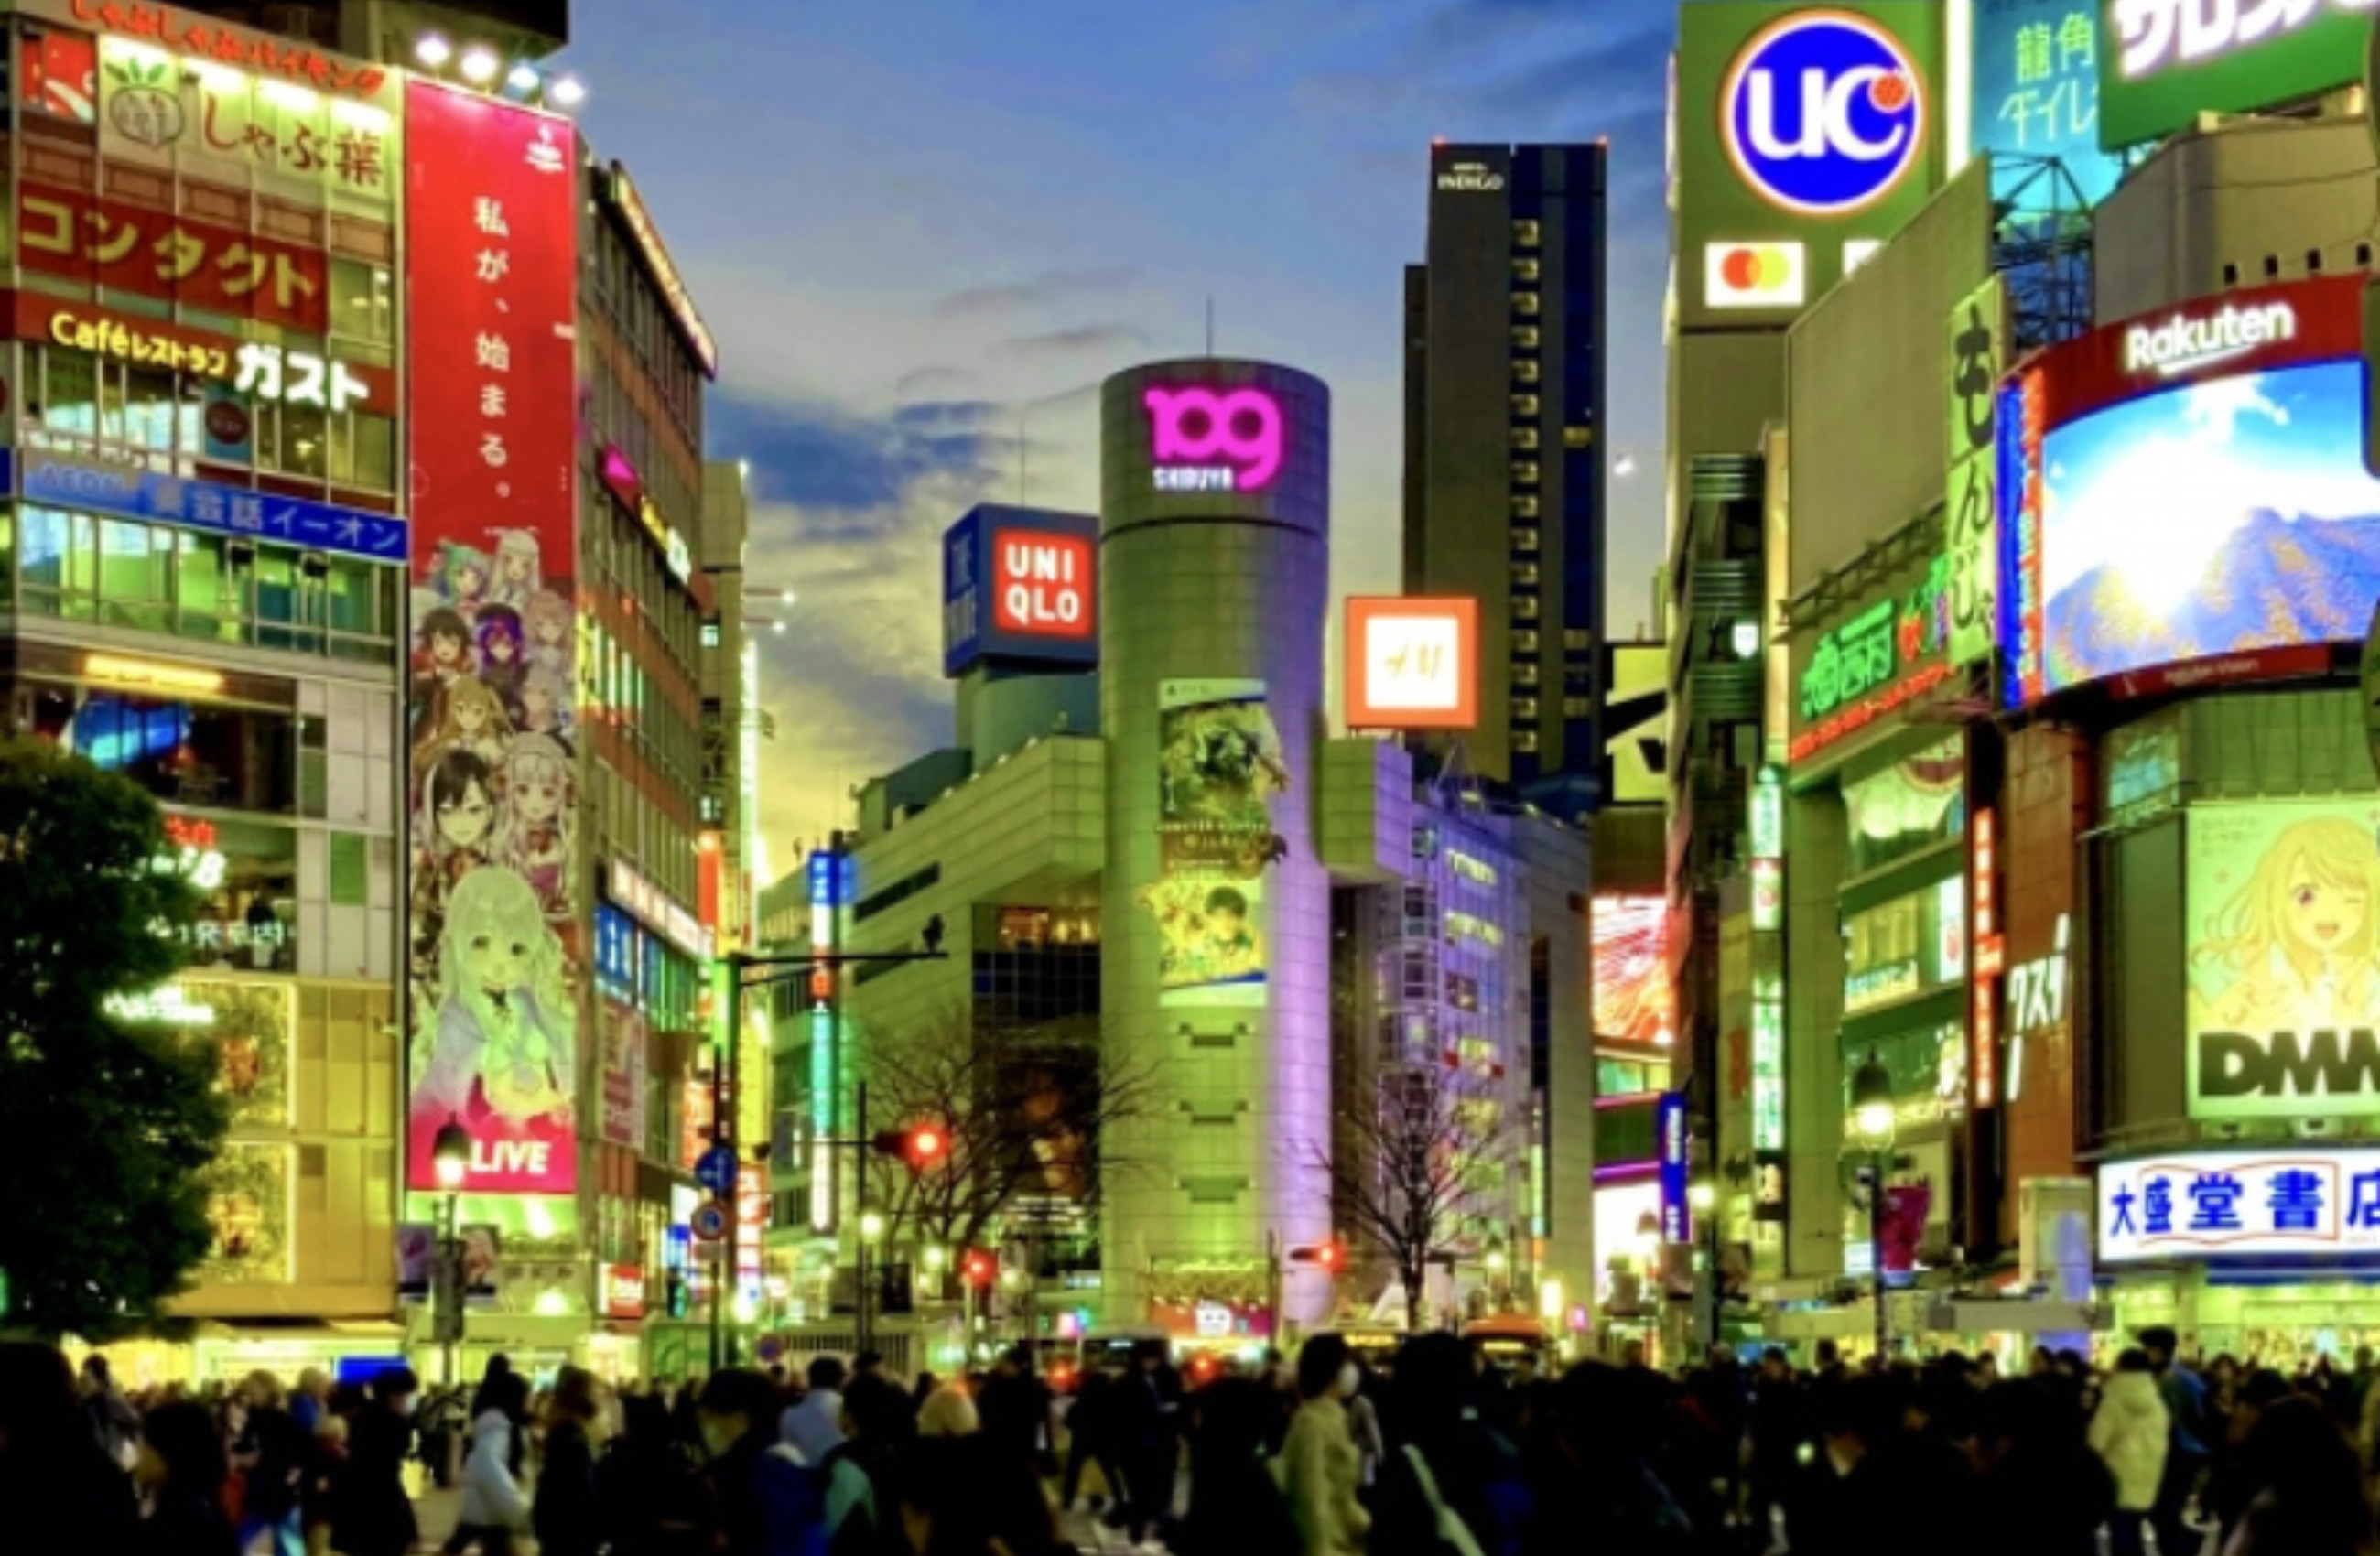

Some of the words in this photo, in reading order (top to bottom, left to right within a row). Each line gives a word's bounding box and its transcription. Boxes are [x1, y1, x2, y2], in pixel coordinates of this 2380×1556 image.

[202, 94, 384, 189] しゃぶ葉
[21, 195, 315, 308] コンタクト
[474, 195, 511, 498] 私が、始まる。
[2126, 300, 2296, 370] Rakuten
[233, 340, 370, 413] ガスト
[1143, 386, 1282, 492] 109
[1005, 545, 1074, 582] UNI
[1005, 584, 1080, 626] QLO
[470, 1140, 552, 1174] LIVE
